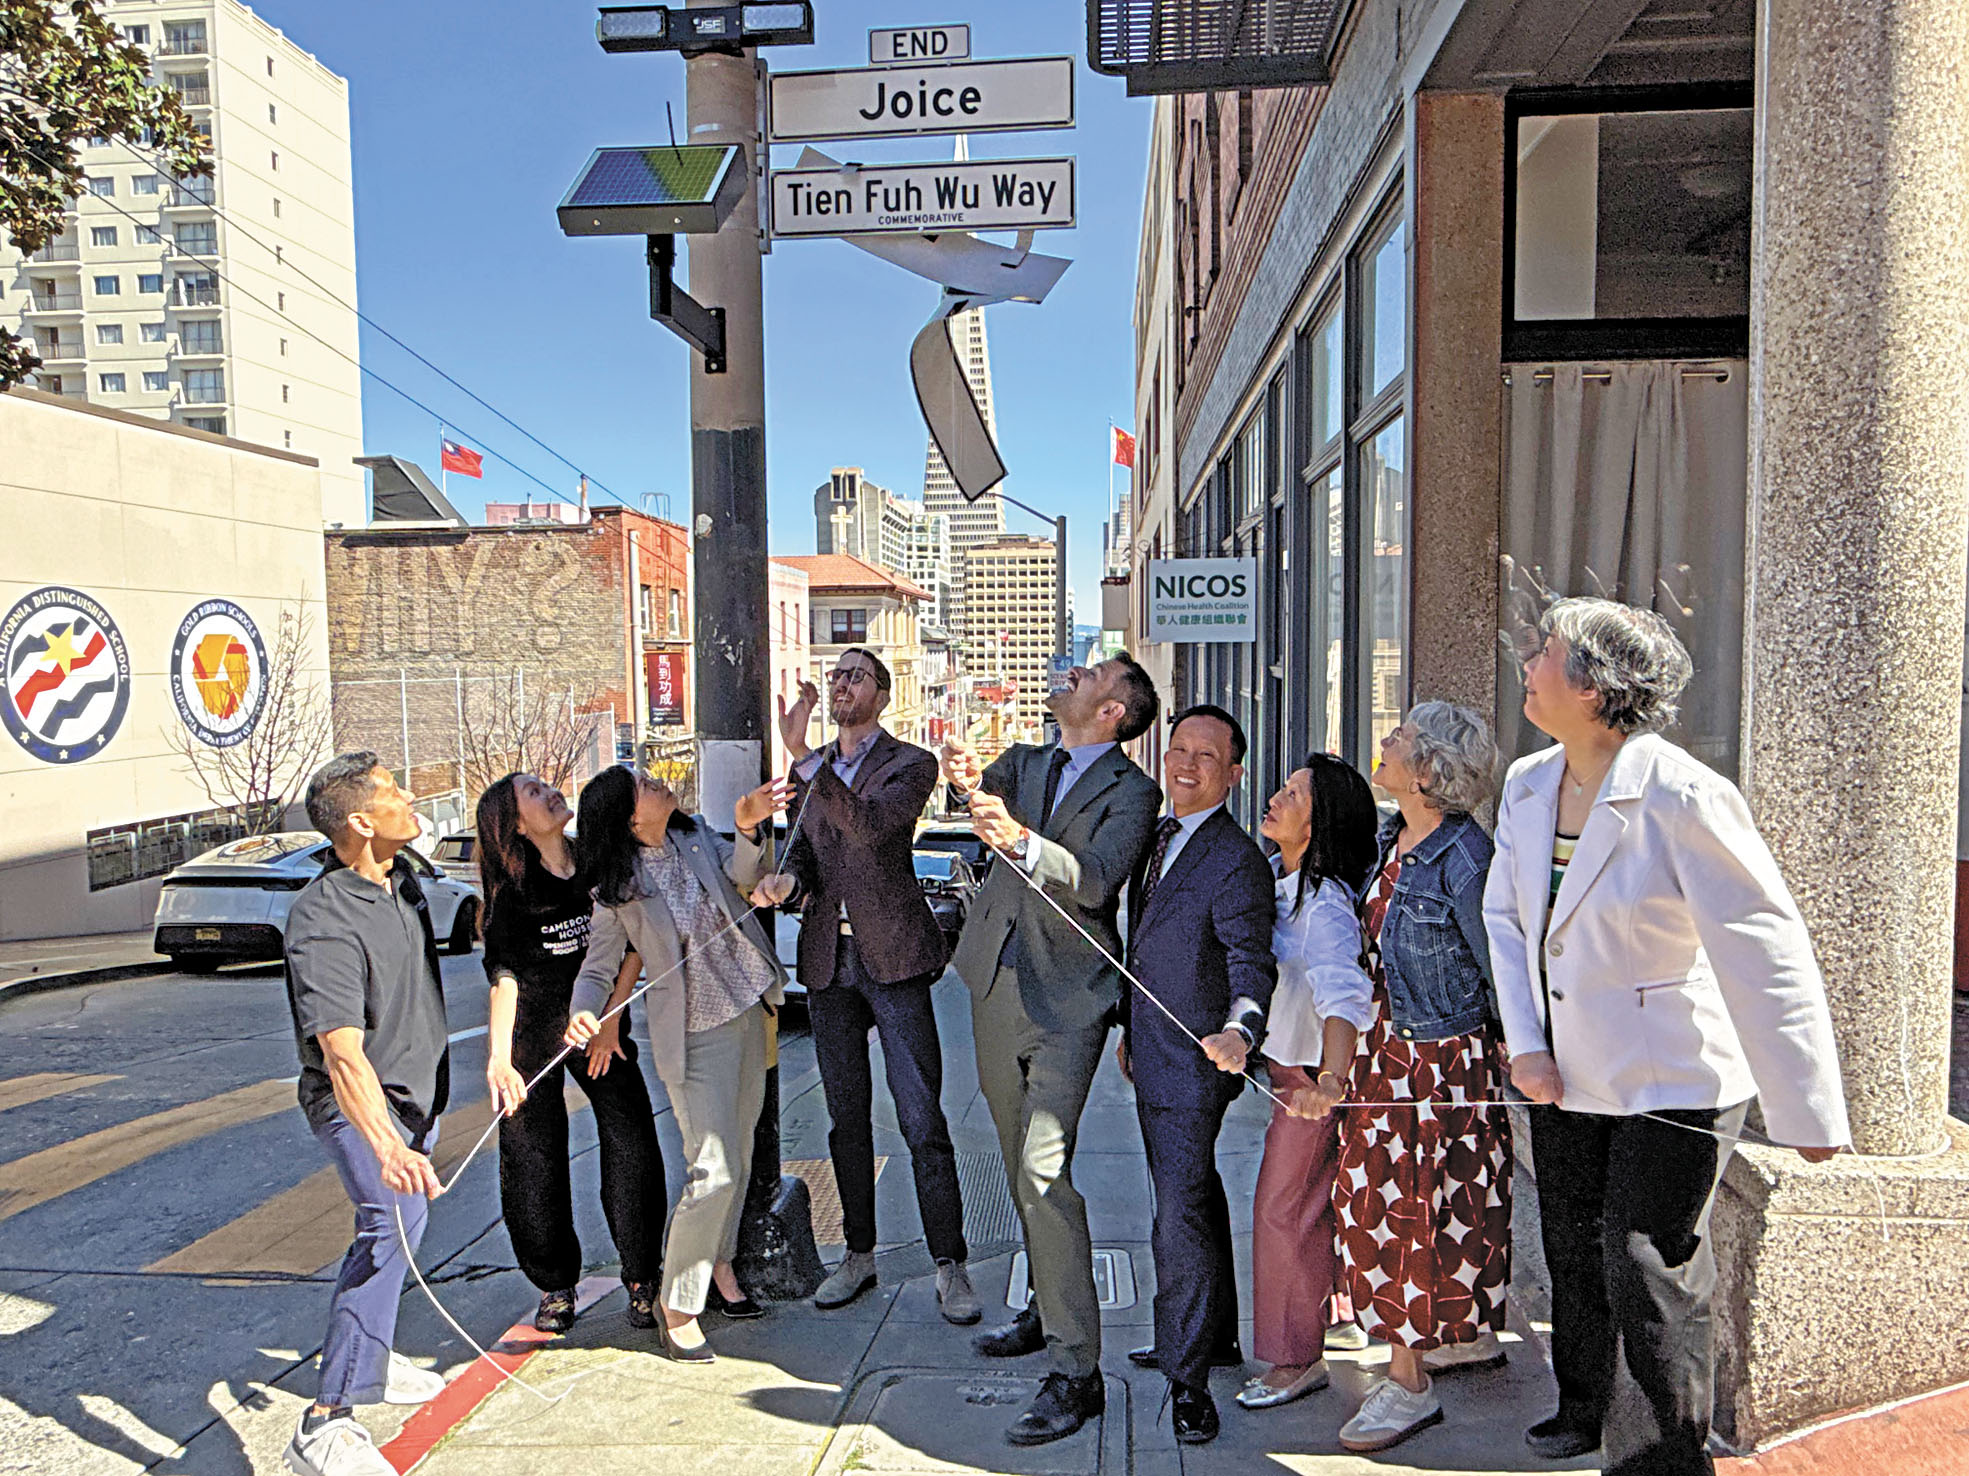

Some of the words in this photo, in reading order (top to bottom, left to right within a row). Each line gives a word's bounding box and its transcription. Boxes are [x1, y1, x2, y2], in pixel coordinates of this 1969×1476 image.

[893, 29, 948, 58] END
[859, 79, 982, 120] Joice
[788, 181, 853, 216] Tien
[865, 178, 923, 213] Fuh
[935, 175, 980, 210] Wu
[993, 173, 1056, 215] Way
[878, 211, 965, 225] COMMEMORATIVE
[1155, 574, 1247, 598] NICOS
[181, 612, 199, 636] GOLD
[198, 602, 227, 617] RIBBON
[227, 604, 257, 638] SCHOOLS
[1156, 602, 1187, 611] Chinese
[1187, 602, 1213, 611] Health
[1214, 601, 1249, 610] Coalition
[32, 590, 110, 627] DISTINGUISHED
[109, 630, 129, 682] SCHOOL
[658, 654, 673, 706] 馬到功成
[172, 674, 198, 733] CALIFORNIA
[541, 914, 591, 934] CAMERON
[558, 922, 592, 940] HOUSE
